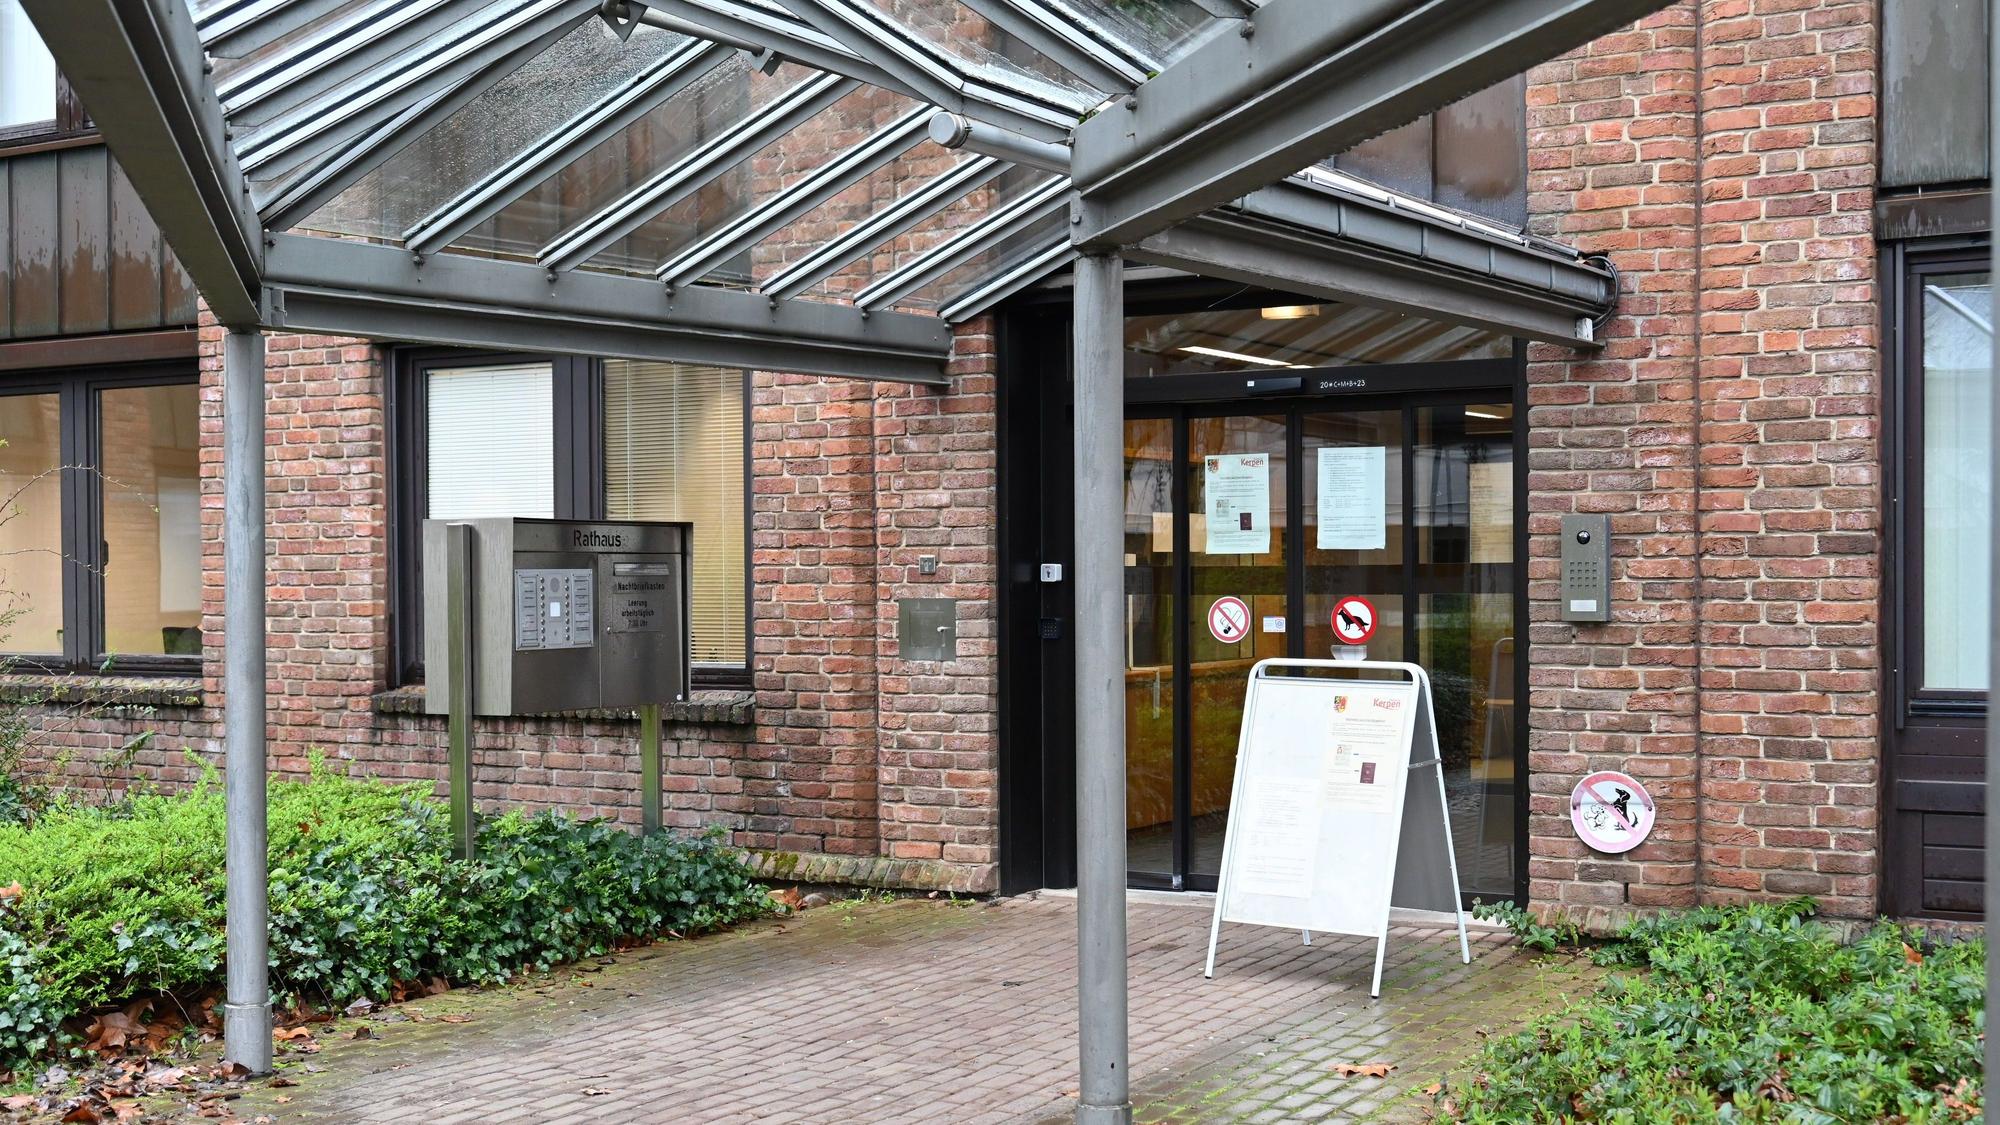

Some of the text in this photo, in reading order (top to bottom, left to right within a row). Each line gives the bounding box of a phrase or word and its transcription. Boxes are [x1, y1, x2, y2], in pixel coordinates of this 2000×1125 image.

[1240, 458, 1264, 467] Kerpen
[573, 528, 622, 547] Rathaus
[617, 582, 665, 592] Nachtbriefkasten
[1373, 698, 1401, 709] Kerpen
